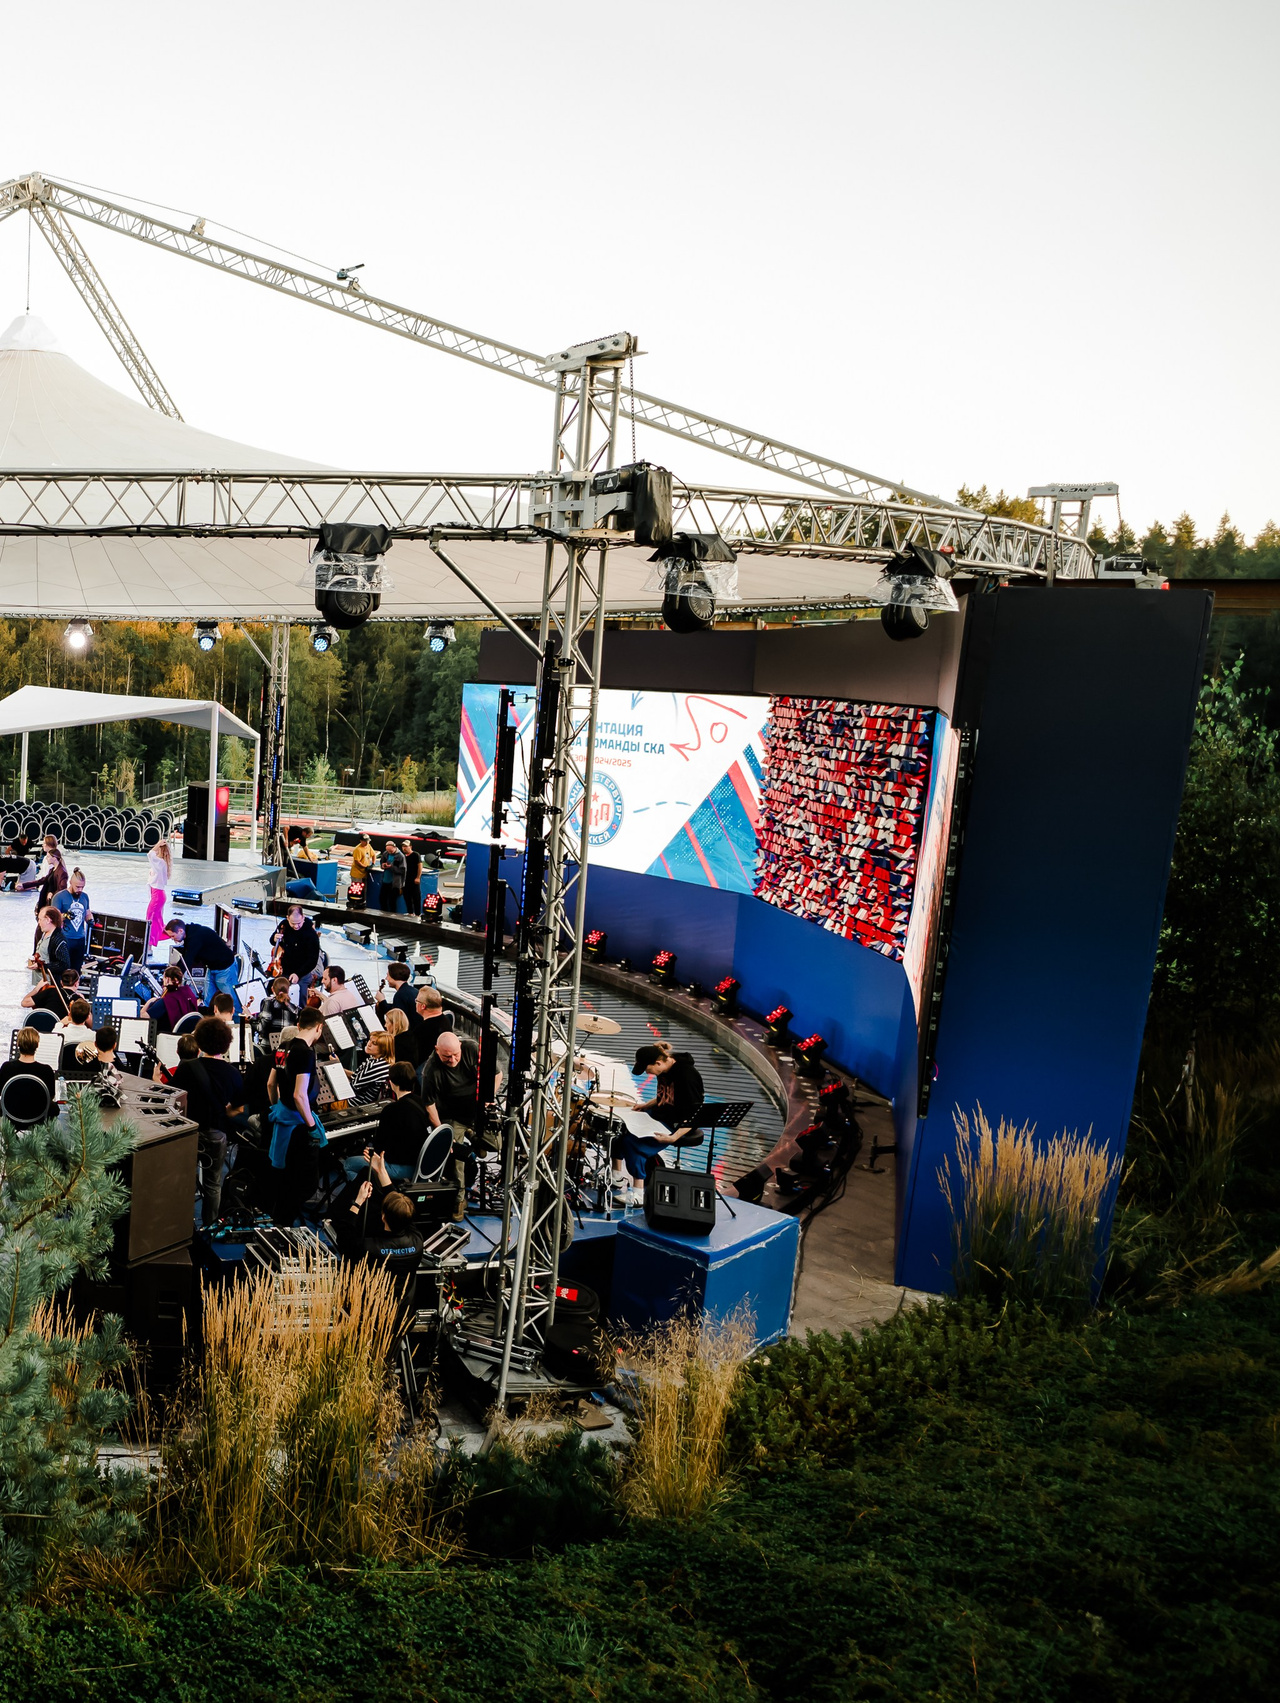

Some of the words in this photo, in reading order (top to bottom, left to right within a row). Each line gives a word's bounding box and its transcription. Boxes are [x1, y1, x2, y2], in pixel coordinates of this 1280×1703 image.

[585, 737, 640, 753] ОМАНДЫ
[643, 742, 665, 755] СКА
[594, 756, 632, 768] 024/2025
[575, 826, 611, 845] ХККЕЙ
[380, 1246, 416, 1255] ОТЕЧЕСТВО
